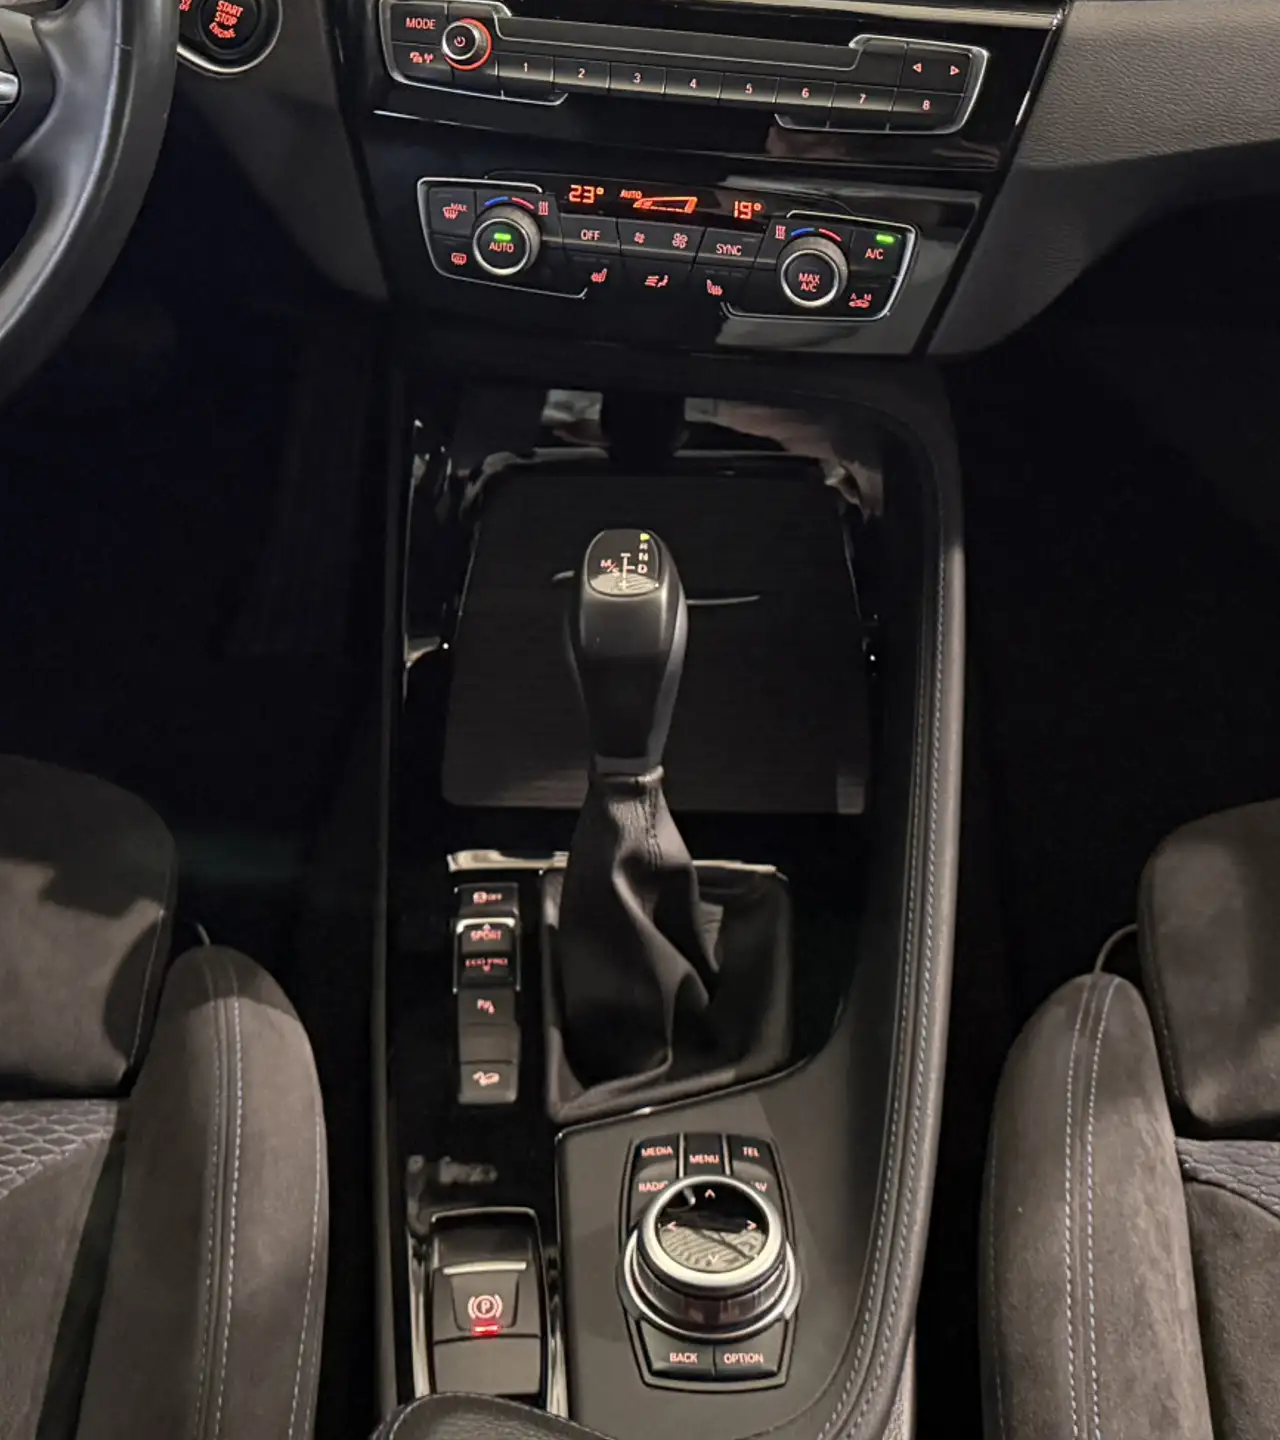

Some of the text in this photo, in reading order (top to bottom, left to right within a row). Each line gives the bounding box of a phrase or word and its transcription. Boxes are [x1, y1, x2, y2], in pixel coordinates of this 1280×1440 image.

[216, 0, 243, 17] START
[214, 11, 238, 26] STOP
[406, 17, 436, 30] MODE
[523, 62, 529, 73] 1
[578, 68, 586, 79] 2
[633, 72, 642, 84] 3
[689, 78, 698, 89] 4
[745, 83, 753, 94] 5
[802, 87, 810, 99] 6
[859, 93, 868, 105] 7
[922, 99, 931, 111] 8
[620, 189, 643, 200] AUTO
[580, 229, 601, 241] OFF
[488, 241, 514, 253] AUTO
[716, 243, 742, 256] SYNC
[865, 248, 884, 260] A/C
[798, 273, 820, 284] MAX
[800, 282, 817, 292] A/C
[638, 552, 648, 562] N
[637, 564, 648, 574] D
[471, 930, 501, 941] SPORT
[641, 1146, 674, 1157] MEDIA
[743, 1146, 760, 1158] TEL
[689, 1154, 720, 1164] MENU
[669, 1352, 698, 1363] BACK
[723, 1353, 764, 1364] OPTION
